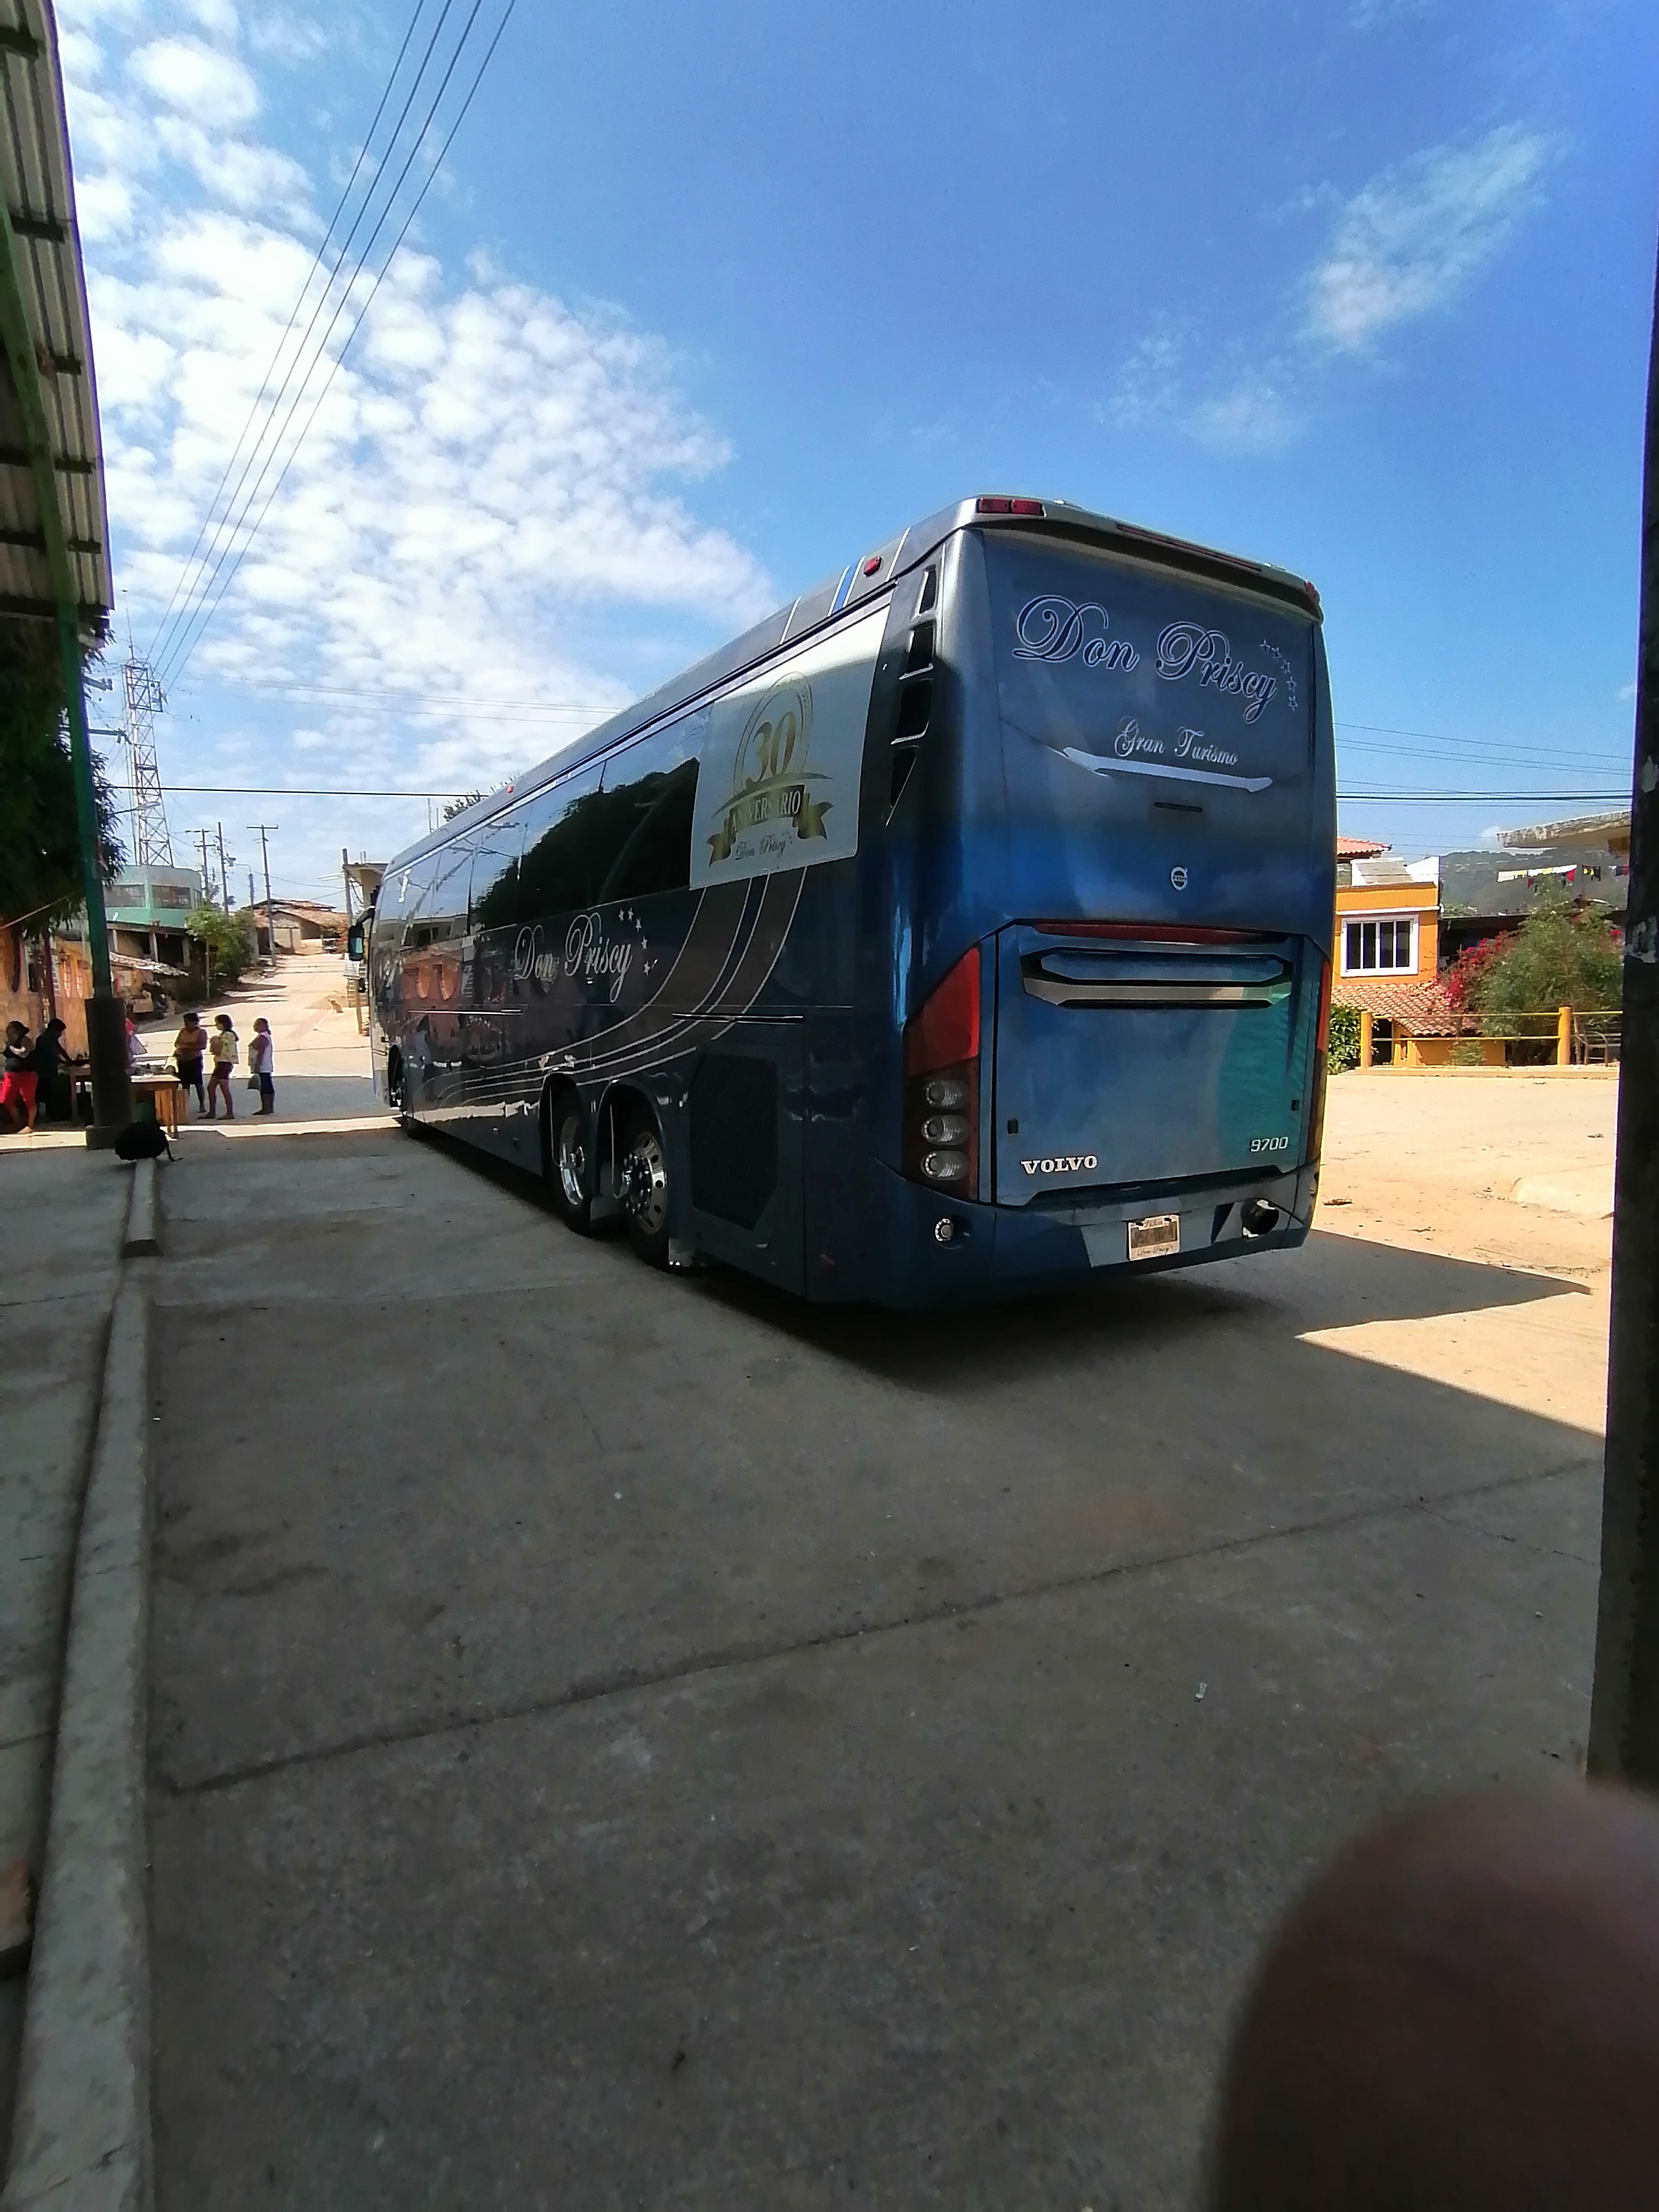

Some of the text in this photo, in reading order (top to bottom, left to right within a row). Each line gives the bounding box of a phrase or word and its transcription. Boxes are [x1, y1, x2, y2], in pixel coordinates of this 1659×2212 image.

[1012, 594, 1279, 724] Don Priscy
[745, 711, 797, 783] 30
[1114, 715, 1239, 766] Gran Turismo
[731, 790, 802, 834] AERRIO
[513, 912, 634, 1003] Don Priscy
[1021, 1155, 1099, 1175] VOLVO
[1250, 1136, 1289, 1153] 9700
